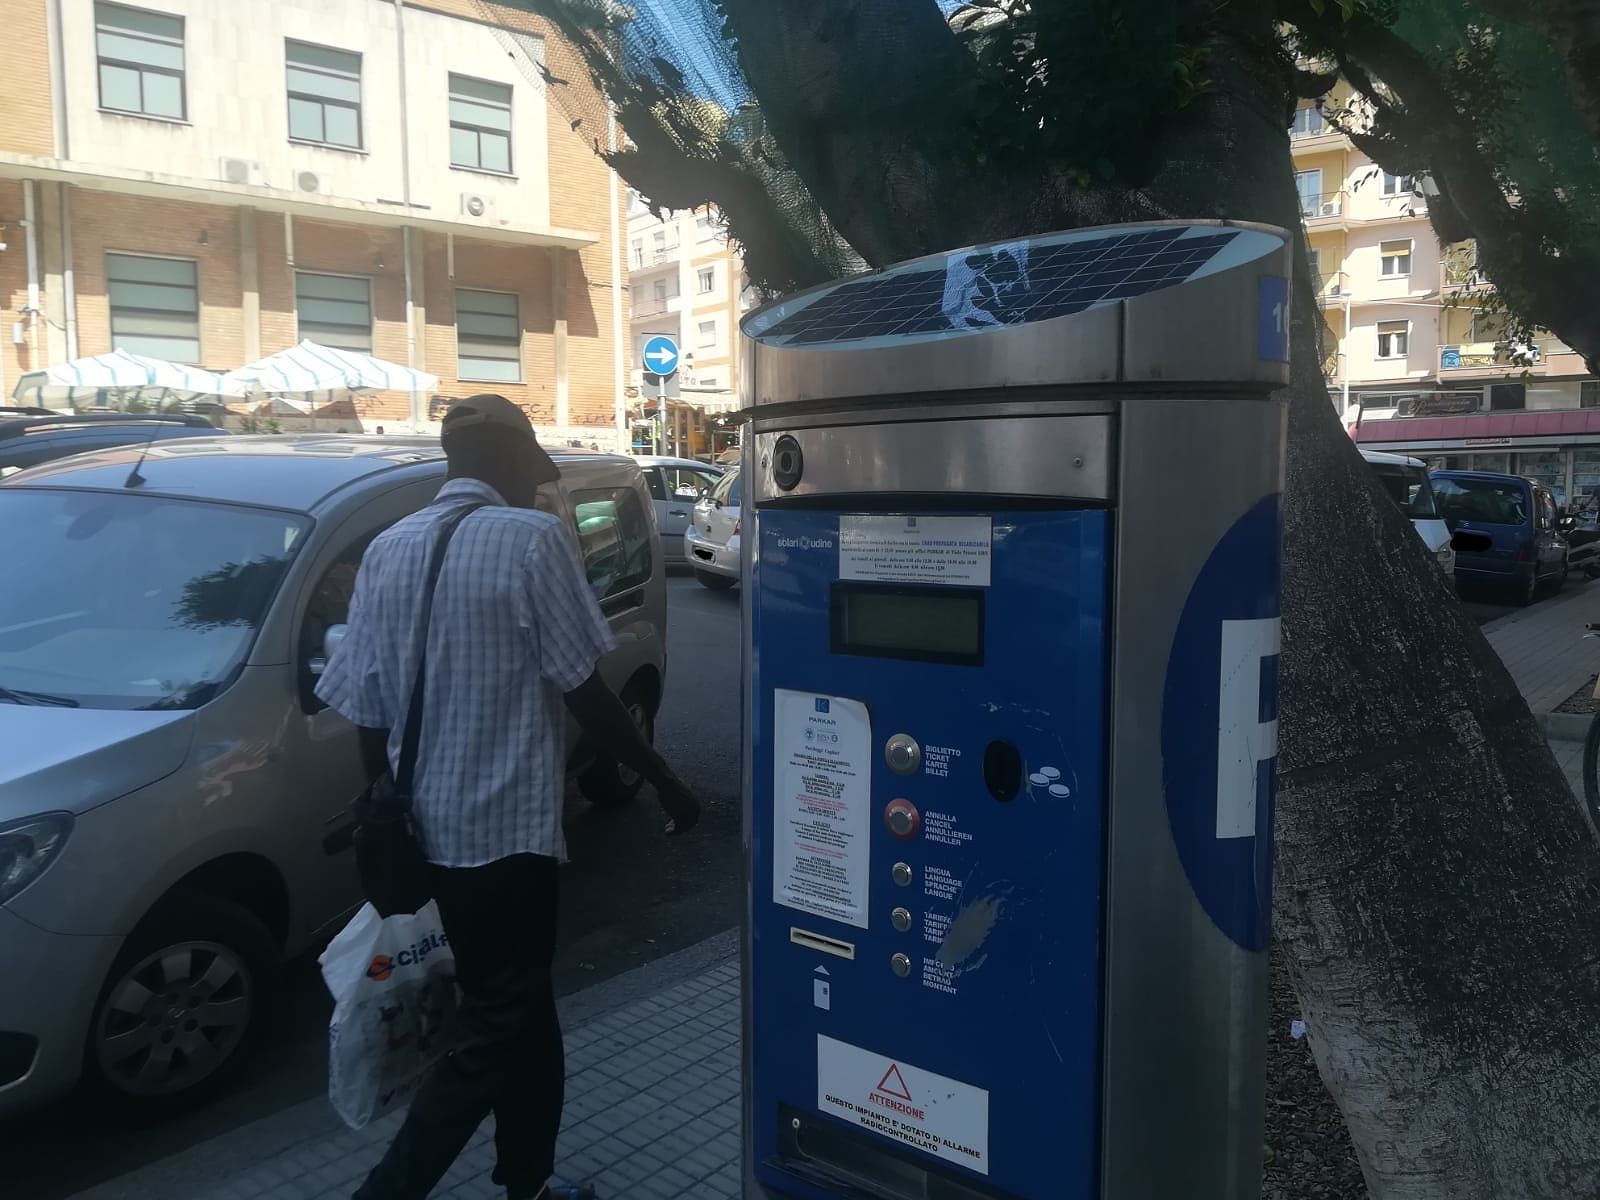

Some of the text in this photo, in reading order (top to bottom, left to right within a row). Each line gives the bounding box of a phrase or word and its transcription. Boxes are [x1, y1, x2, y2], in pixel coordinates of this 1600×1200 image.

[925, 744, 961, 757] BIGLIETTO
[925, 752, 950, 762] TICKET
[925, 759, 948, 770] KARTE
[925, 767, 948, 777] BILLET
[925, 810, 957, 822] ANNULLA
[925, 818, 952, 830] CANCEL
[925, 826, 973, 841] ANNULLIEREN
[925, 833, 961, 847] ANNULLER
[924, 865, 952, 878] LINGUA
[924, 872, 963, 888] LANGUAGE
[924, 880, 958, 895] SPRACHE
[924, 887, 953, 900] LANGUE
[923, 979, 957, 995] MONTANT
[868, 1092, 926, 1120] ATTENZIONE
[825, 1094, 854, 1111] QUESTO
[855, 1106, 891, 1125] IMPIANTO
[900, 1122, 931, 1140] DOTATO
[932, 1134, 941, 1145] DI
[942, 1139, 982, 1159] ALLARME
[860, 1116, 938, 1153] RADIOCONTROLLATO
